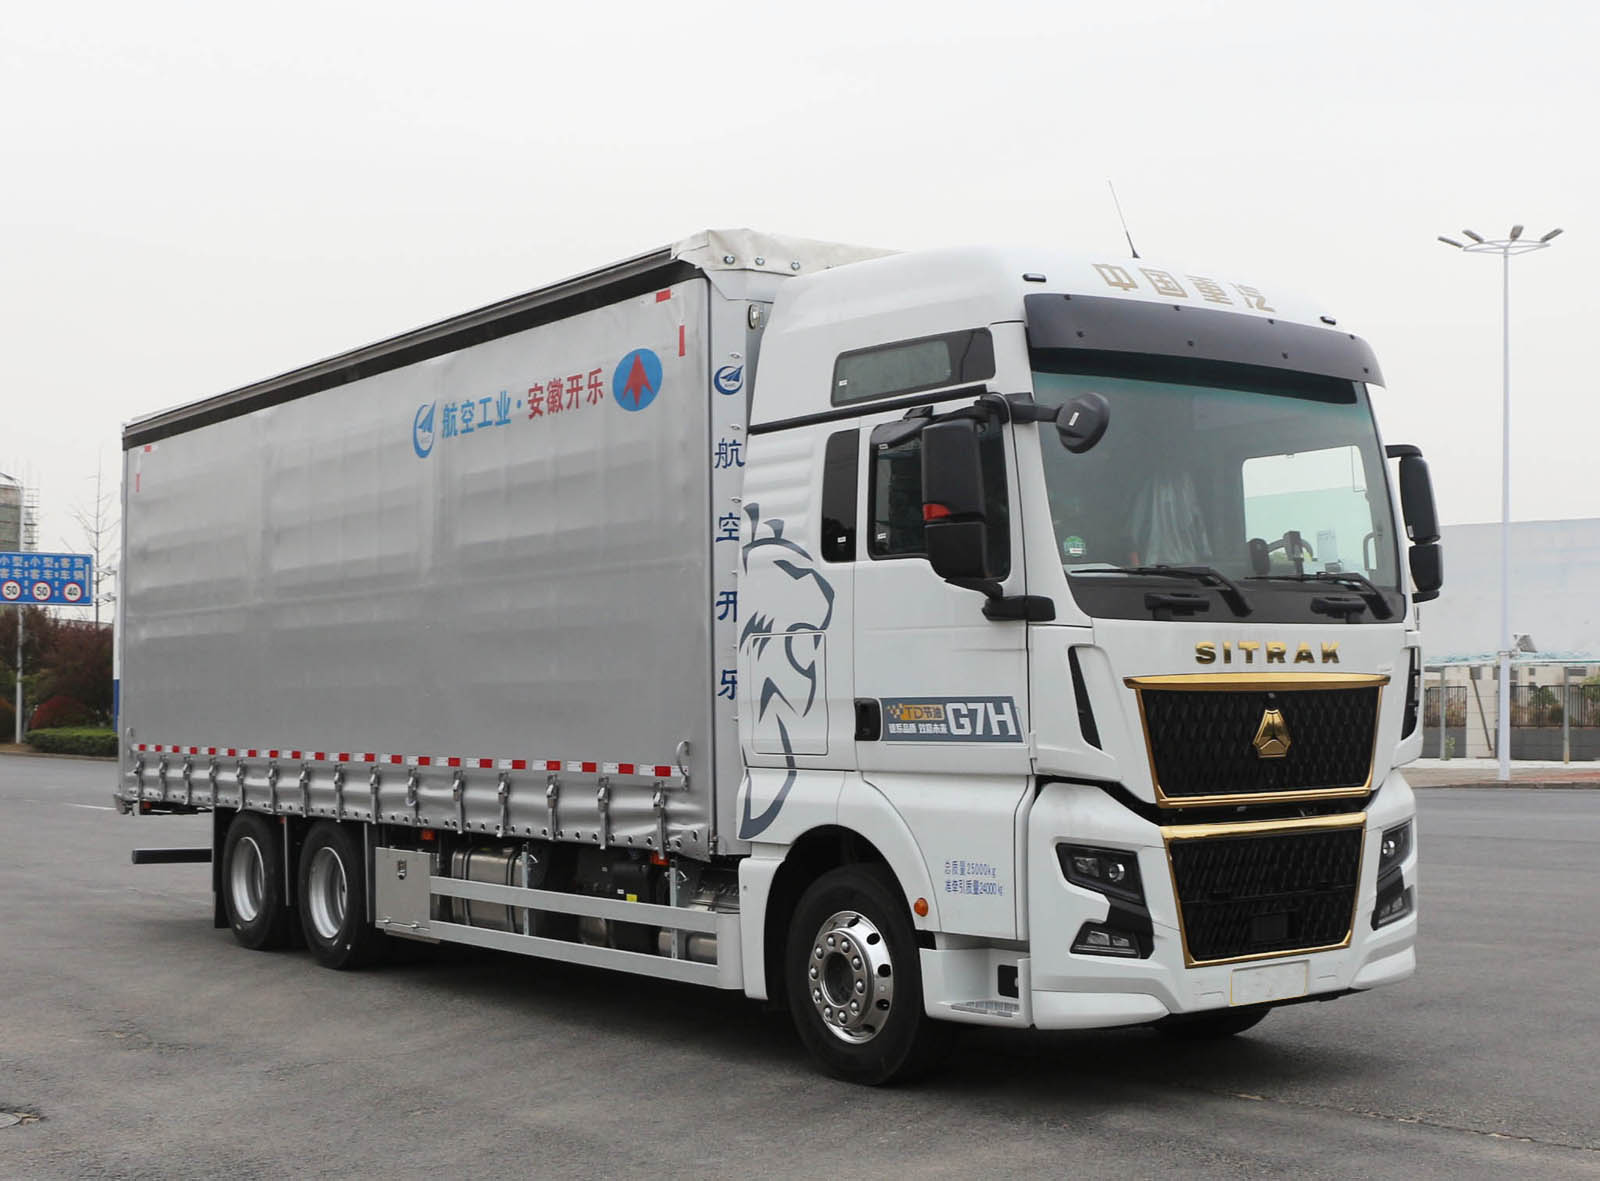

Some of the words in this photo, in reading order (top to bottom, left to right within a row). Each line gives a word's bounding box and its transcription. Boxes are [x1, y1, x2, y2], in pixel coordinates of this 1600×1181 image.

[1091, 263, 1276, 313] 中国重汽
[6, 585, 18, 595] 50
[36, 586, 48, 596] 50
[67, 587, 78, 596] 40
[1195, 640, 1340, 664] SITRAK
[945, 702, 1017, 735] G7H
